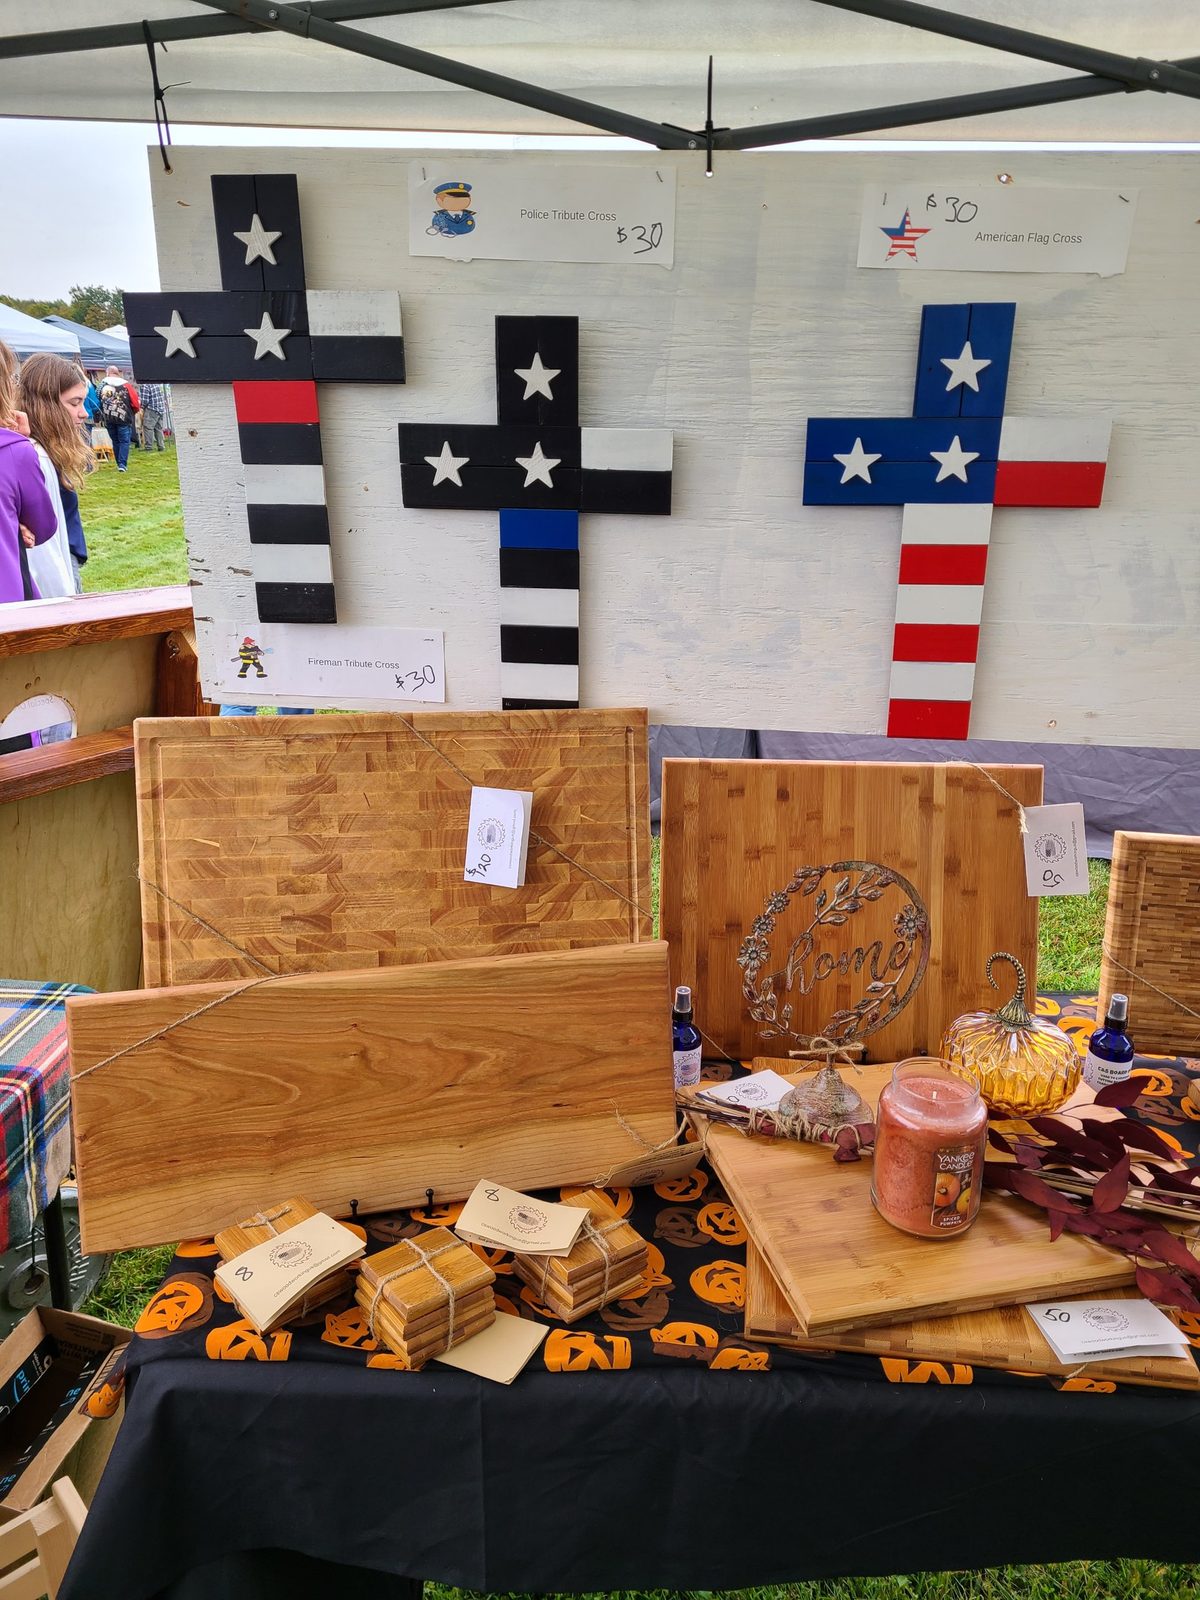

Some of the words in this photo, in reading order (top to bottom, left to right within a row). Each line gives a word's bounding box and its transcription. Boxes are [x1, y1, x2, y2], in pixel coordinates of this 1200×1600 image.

[520, 209, 549, 220] Police
[551, 210, 585, 221] Tribute
[587, 211, 617, 221] Cross
[616, 222, 663, 254] $30
[975, 231, 1025, 242] American
[1027, 232, 1050, 245] Flag
[1052, 233, 1083, 243] Cross
[308, 658, 342, 667] Fireman
[344, 659, 373, 668] Tribute
[375, 661, 400, 669] Cross
[395, 665, 436, 692] $30
[785, 932, 908, 995] home
[485, 1188, 500, 1202] 8
[235, 1266, 254, 1281] 8
[1043, 1308, 1071, 1323] 50
